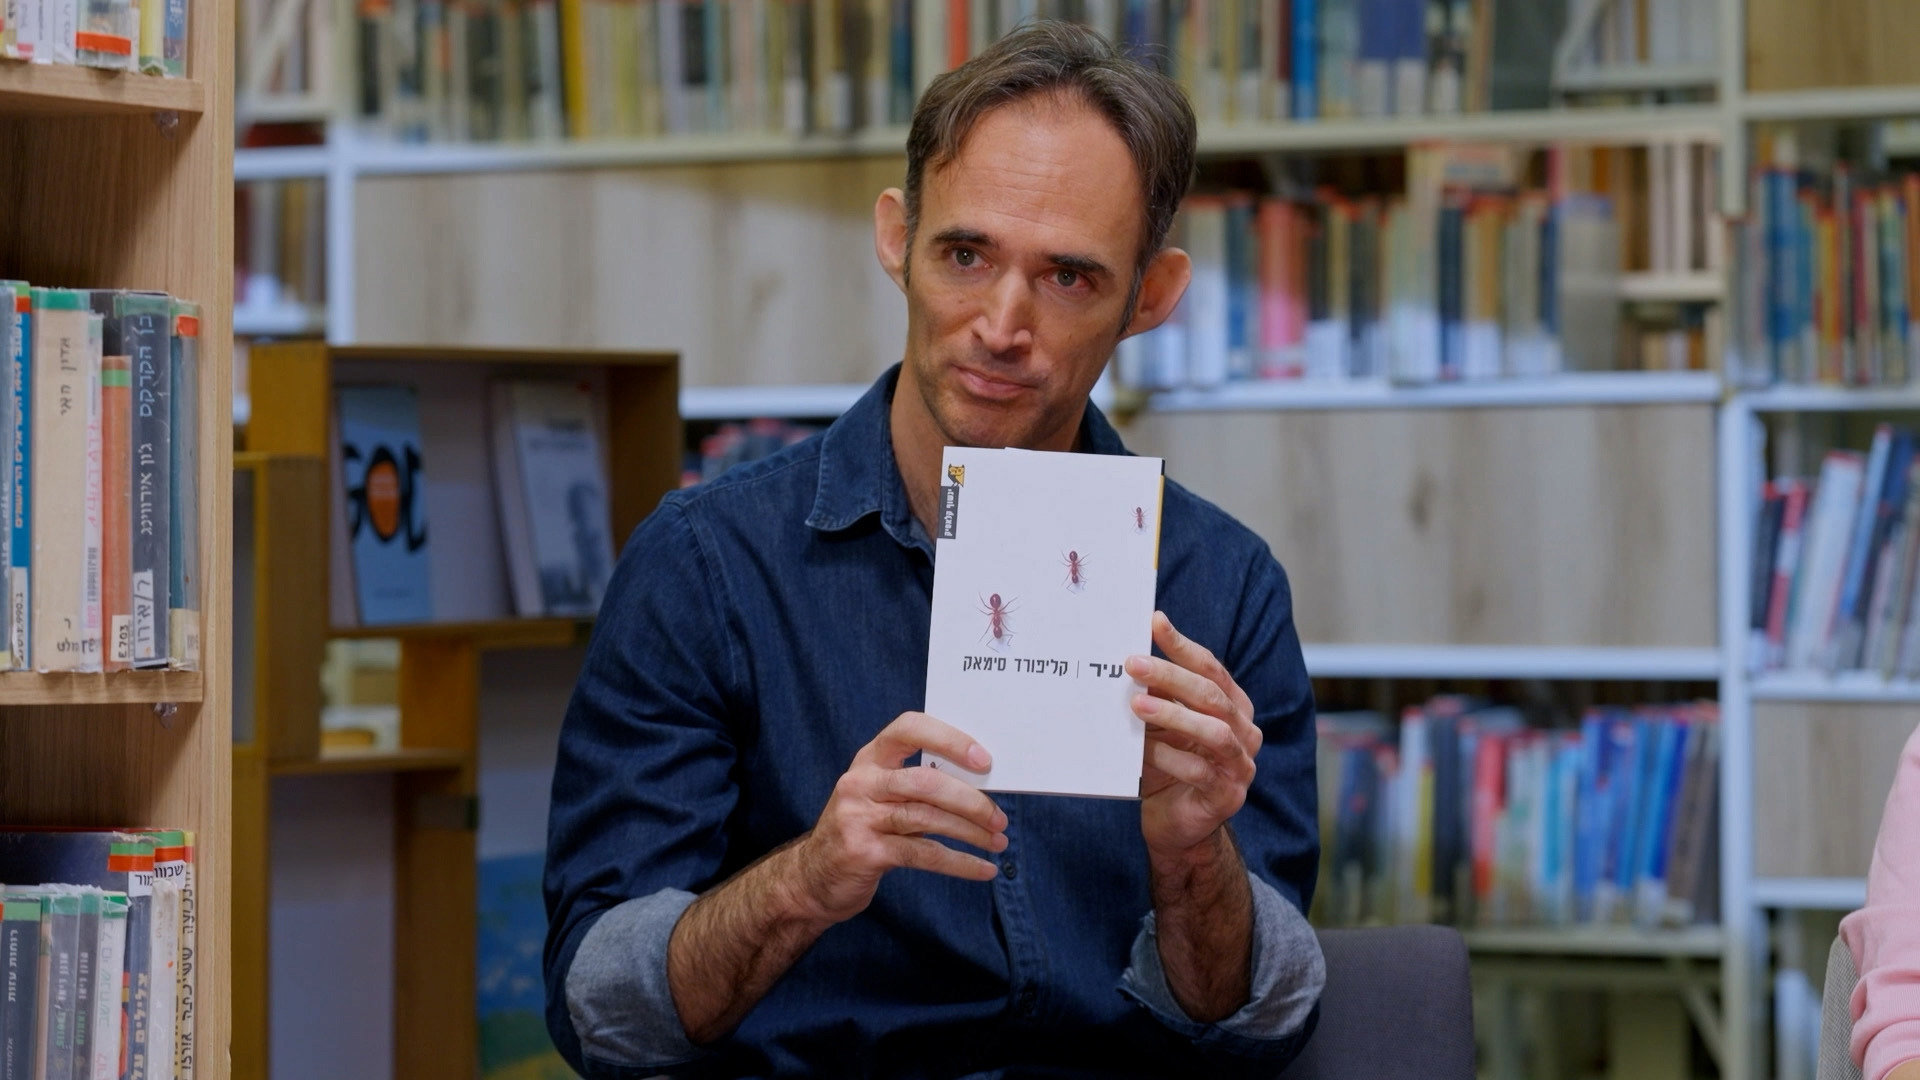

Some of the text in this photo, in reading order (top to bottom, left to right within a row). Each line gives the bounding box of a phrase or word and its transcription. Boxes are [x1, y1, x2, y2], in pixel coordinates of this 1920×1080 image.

[139, 346, 155, 417] הקרקס
[138, 443, 155, 535] ג'ון אירווינג
[944, 488, 955, 537] ינשוף קלאסיק
[963, 655, 1123, 679] עיר קליפורד סימאק
[8, 929, 19, 1002] רוחות עזות
